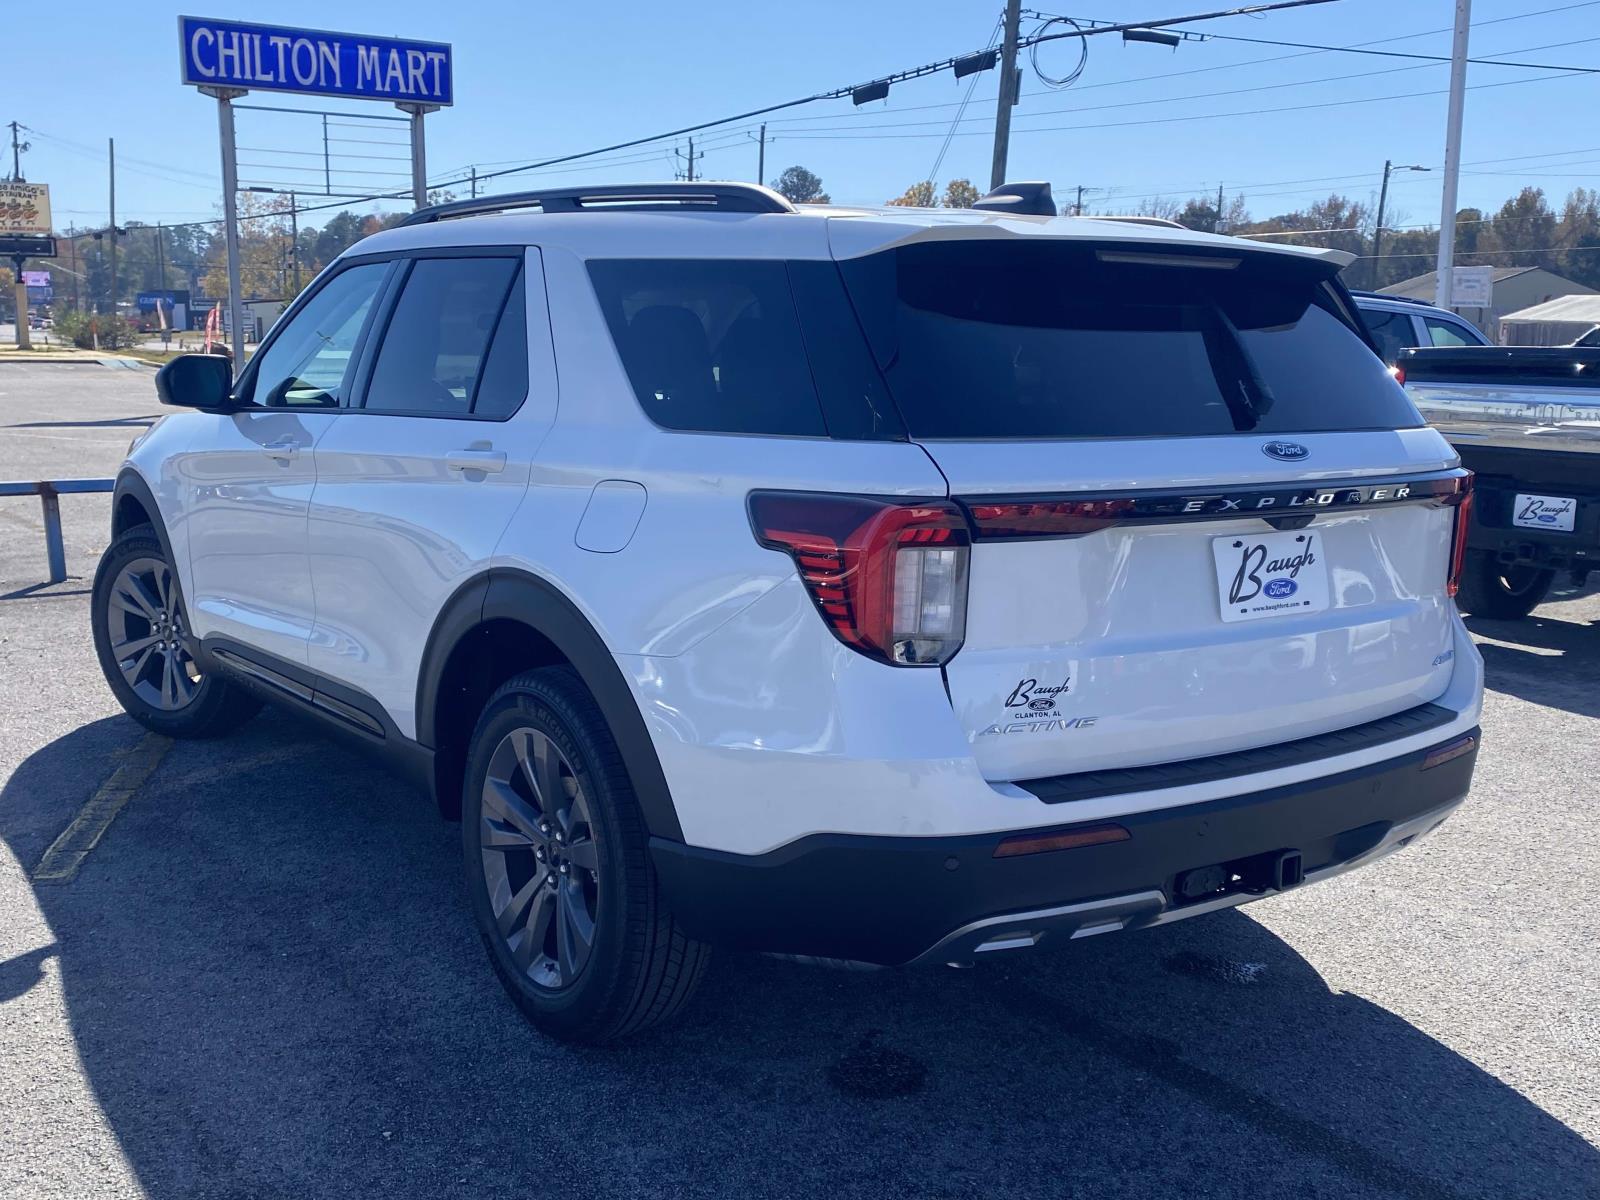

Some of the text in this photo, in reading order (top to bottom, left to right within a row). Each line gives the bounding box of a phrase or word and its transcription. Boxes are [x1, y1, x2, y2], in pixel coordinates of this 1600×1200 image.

[191, 27, 446, 97] CHILTON MART
[1275, 443, 1303, 455] Ford
[1182, 488, 1410, 512] EXPLORER
[1518, 500, 1571, 520] Baugh
[1229, 535, 1316, 605] Baugh
[1270, 582, 1292, 595] Ford
[1005, 677, 1070, 708] Baugh
[1015, 711, 1051, 719] CLANTON,
[978, 716, 1100, 737] ACTIVE
[538, 708, 582, 771] MICHELIN
